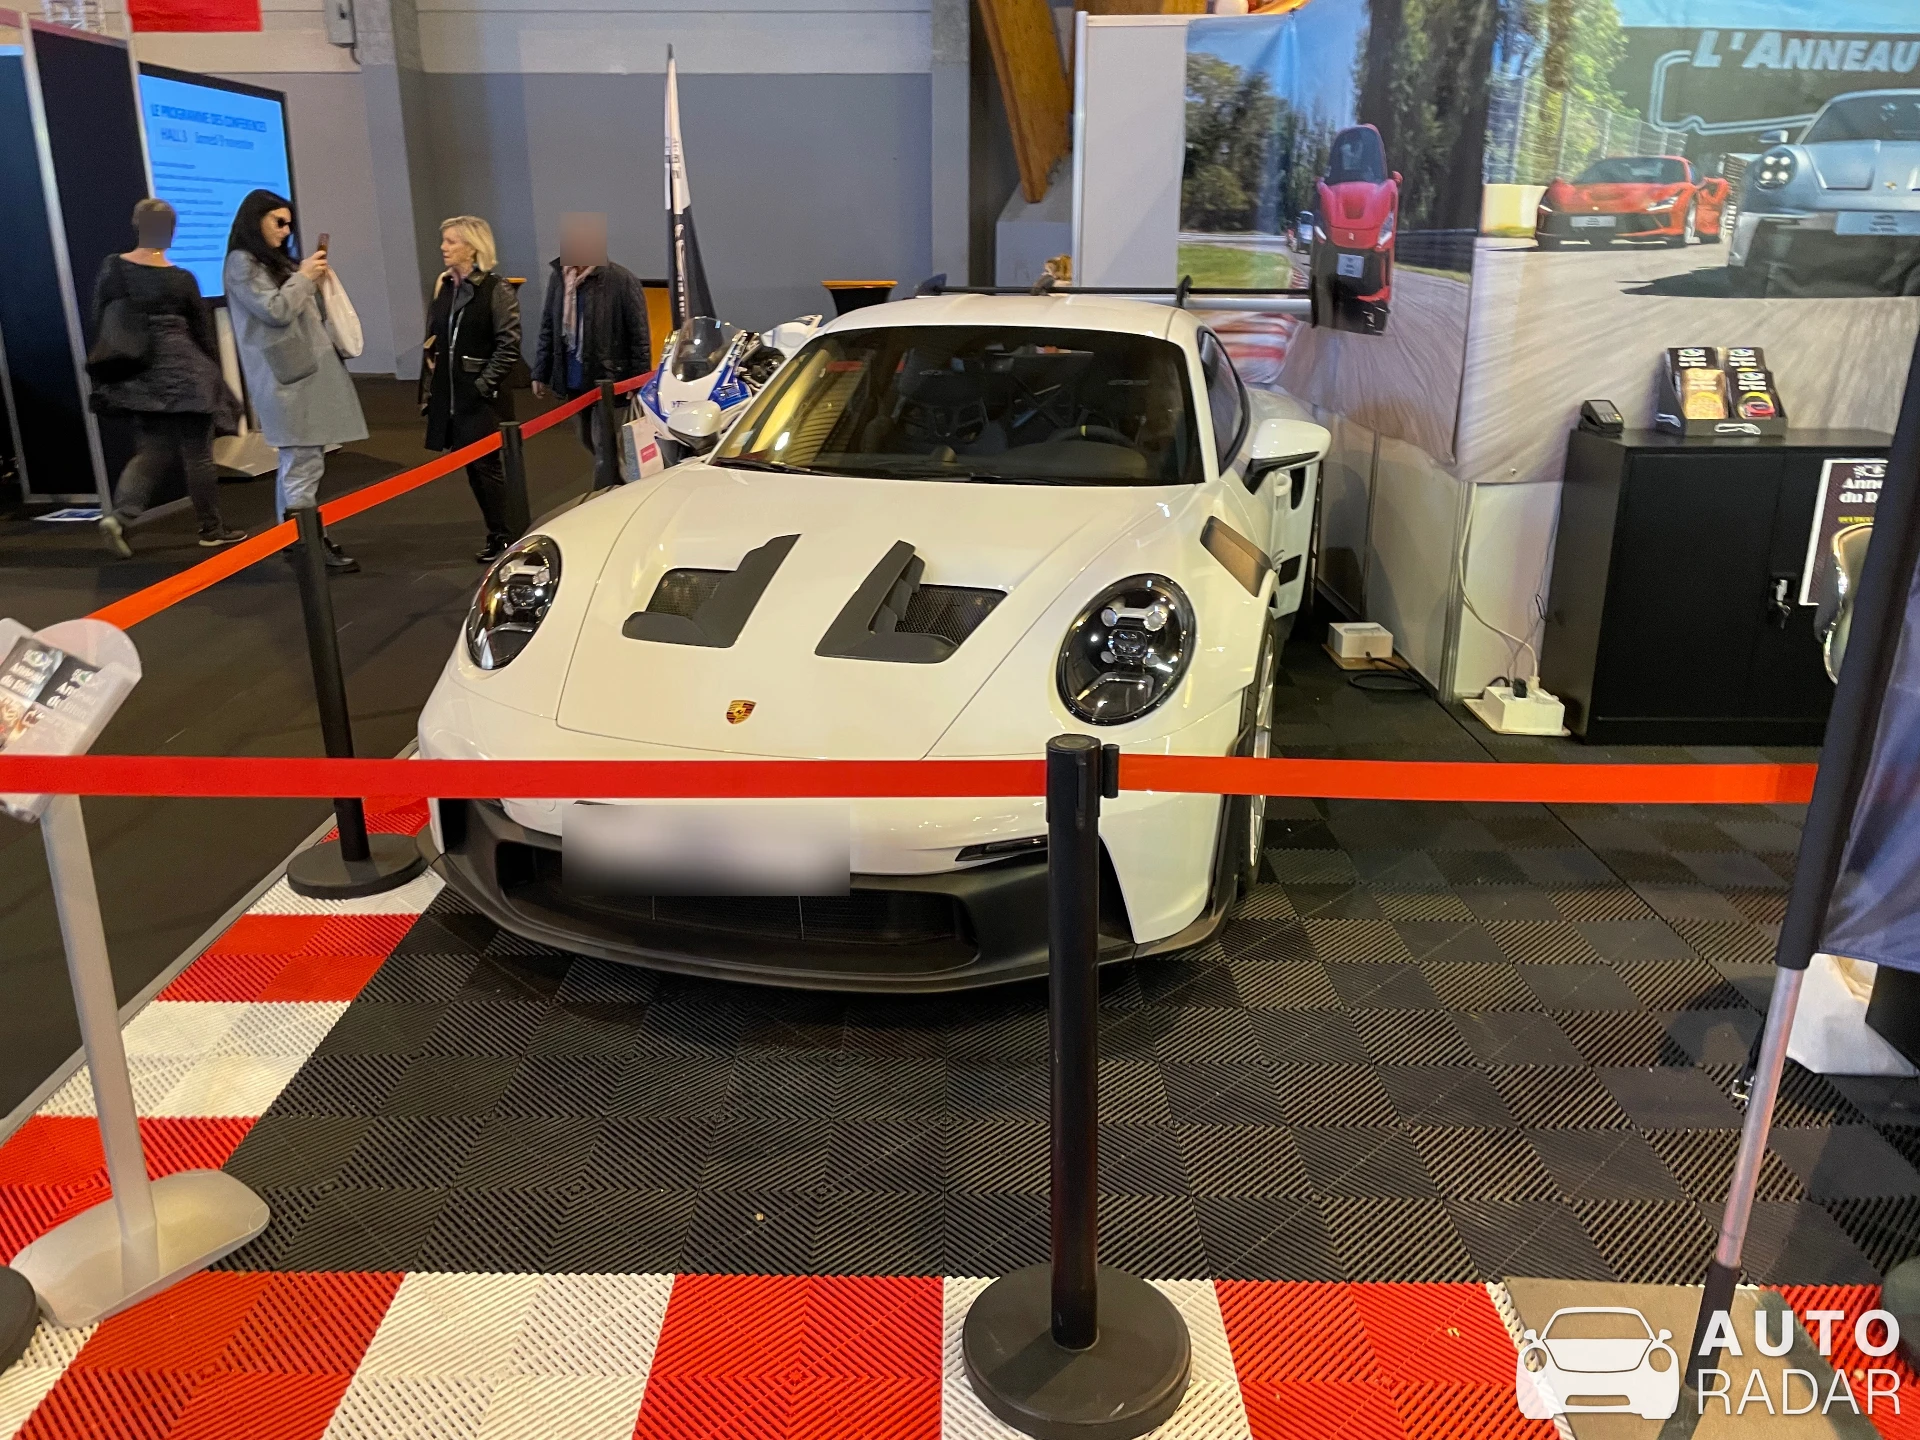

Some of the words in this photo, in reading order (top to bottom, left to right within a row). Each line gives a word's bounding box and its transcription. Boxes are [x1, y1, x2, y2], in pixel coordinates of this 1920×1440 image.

[1692, 29, 1920, 74] L'ANNEAU
[151, 103, 161, 118] LE
[1841, 477, 1883, 489] Anne
